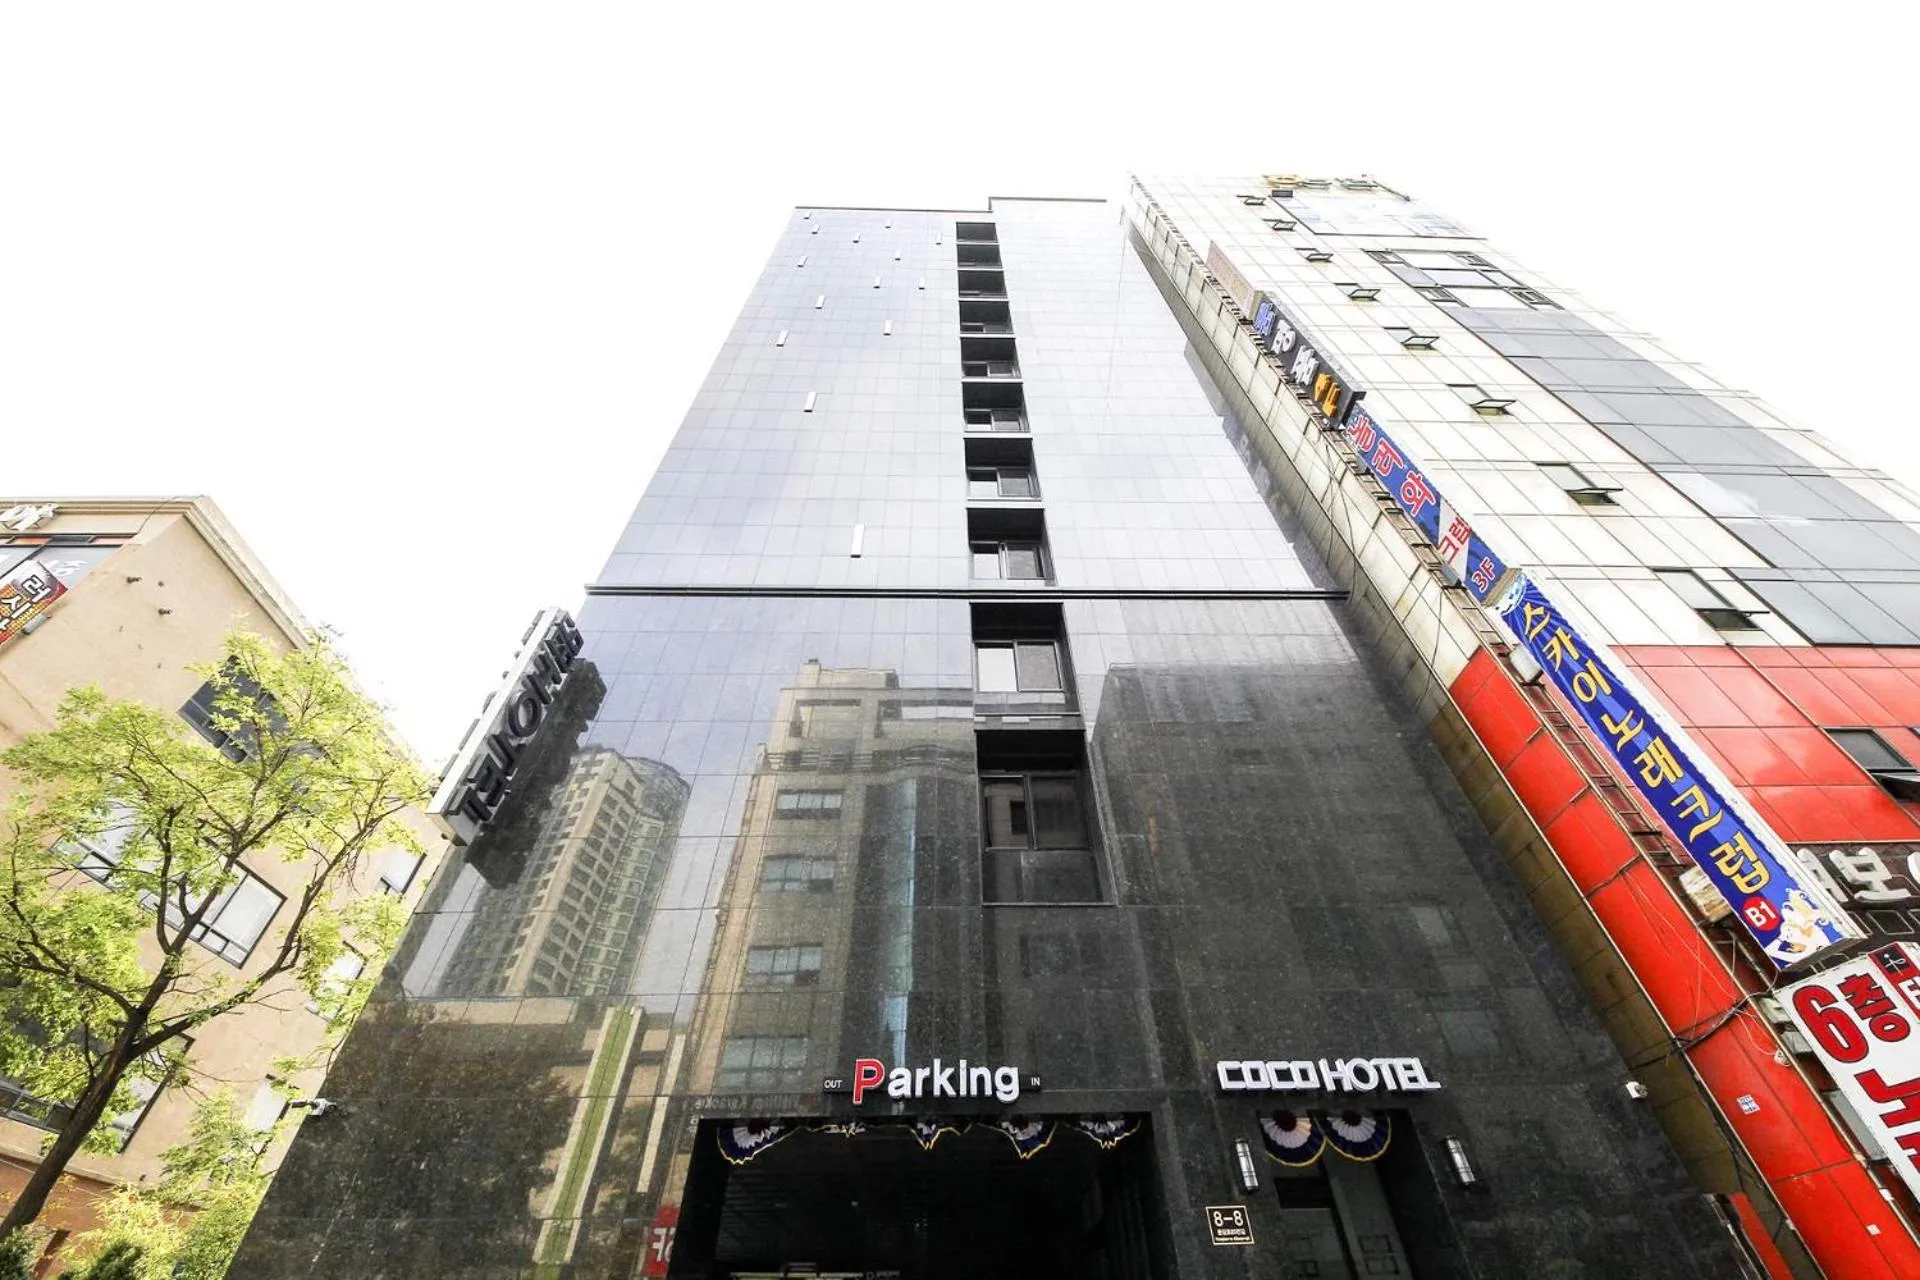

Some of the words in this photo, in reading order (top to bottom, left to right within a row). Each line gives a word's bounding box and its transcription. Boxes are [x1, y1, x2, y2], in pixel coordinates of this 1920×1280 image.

[1472, 556, 1496, 593] 3F
[447, 652, 564, 823] HOTEL
[1744, 900, 1777, 928] B1
[824, 1079, 842, 1089] OUT
[852, 1058, 1020, 1105] Parking
[1031, 1076, 1041, 1087] IN
[1318, 1057, 1442, 1092] HOTEL
[1213, 1210, 1244, 1227] 8-8
